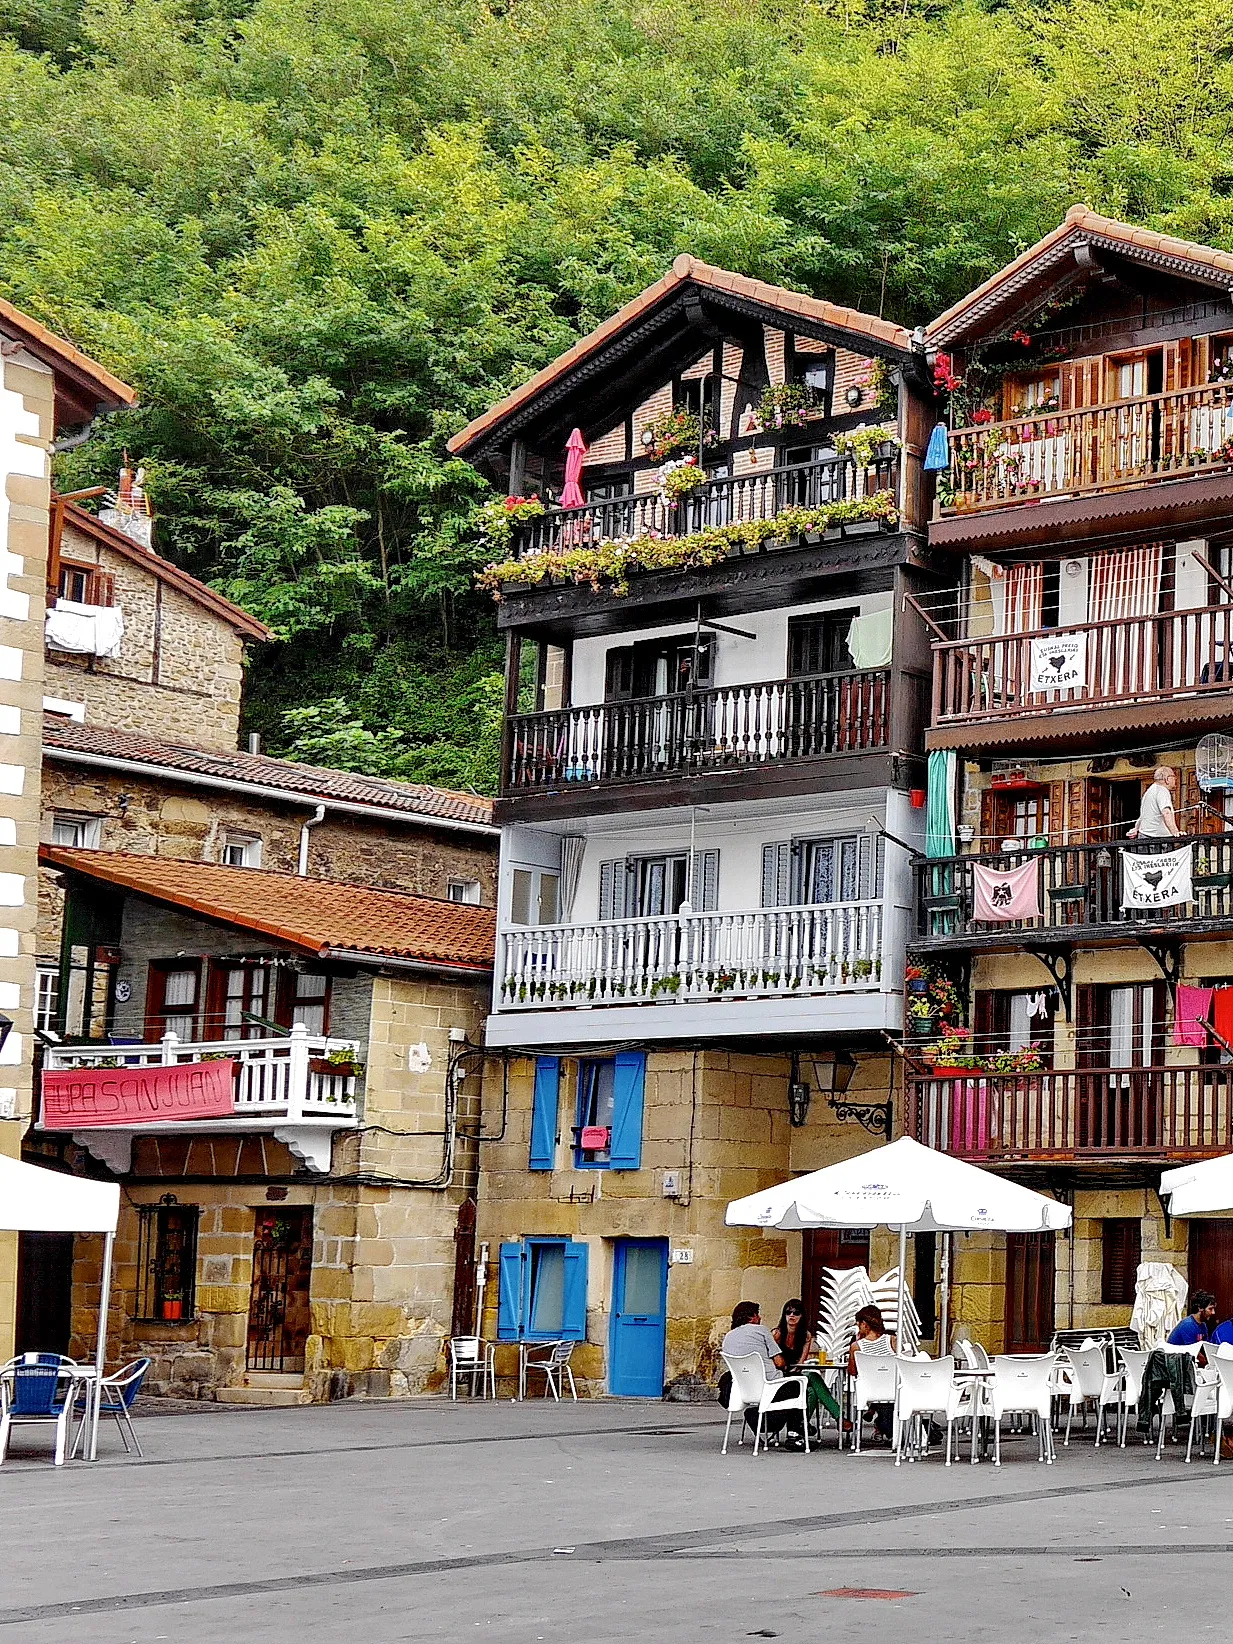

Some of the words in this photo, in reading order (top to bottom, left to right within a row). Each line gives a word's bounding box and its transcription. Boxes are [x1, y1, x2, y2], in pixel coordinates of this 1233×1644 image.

[1038, 670, 1079, 684] ETXERA
[1132, 886, 1179, 903] ETXERA
[101, 1077, 159, 1112] SAN
[162, 1068, 223, 1108] JUAN
